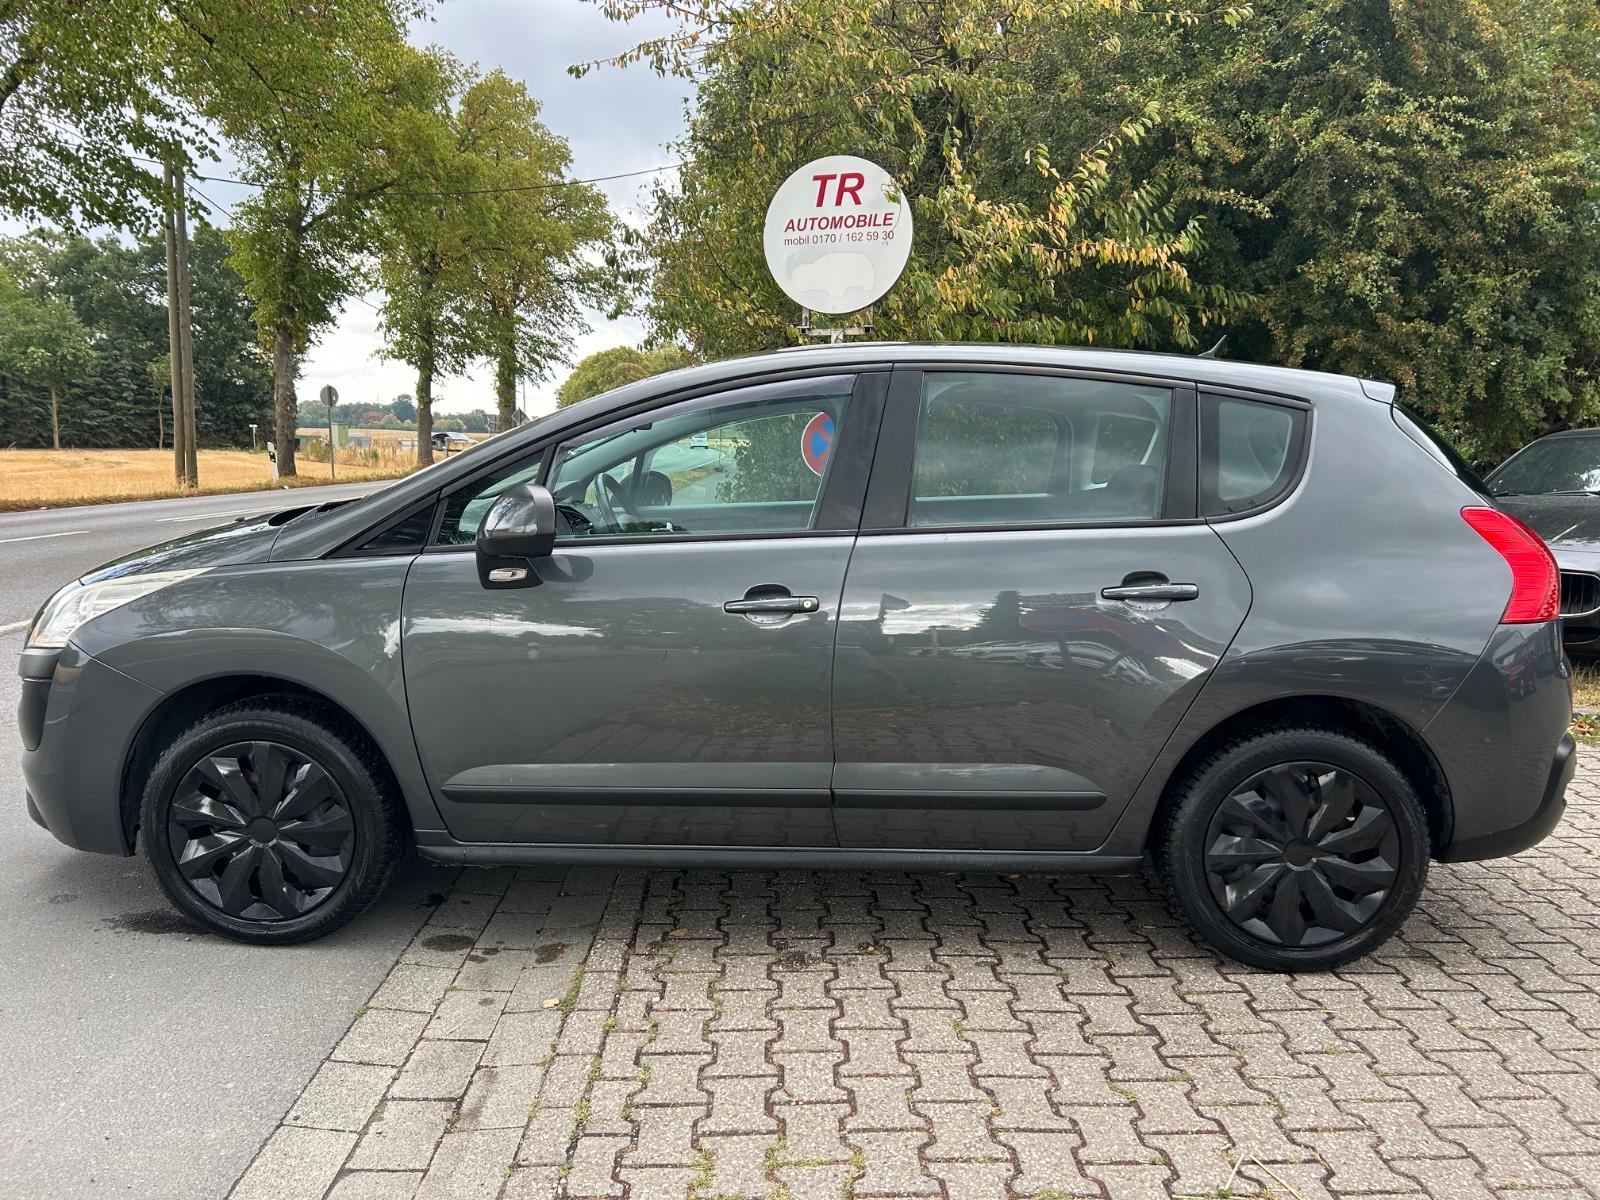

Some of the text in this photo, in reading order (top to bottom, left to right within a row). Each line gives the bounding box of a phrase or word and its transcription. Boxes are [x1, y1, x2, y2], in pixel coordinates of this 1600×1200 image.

[812, 172, 865, 208] TR
[784, 212, 894, 233] AUTOMOBILE
[784, 235, 810, 246] mobil
[812, 233, 837, 245] 0170
[846, 232, 864, 242] 162
[866, 231, 879, 241] 59
[882, 230, 895, 240] 30
